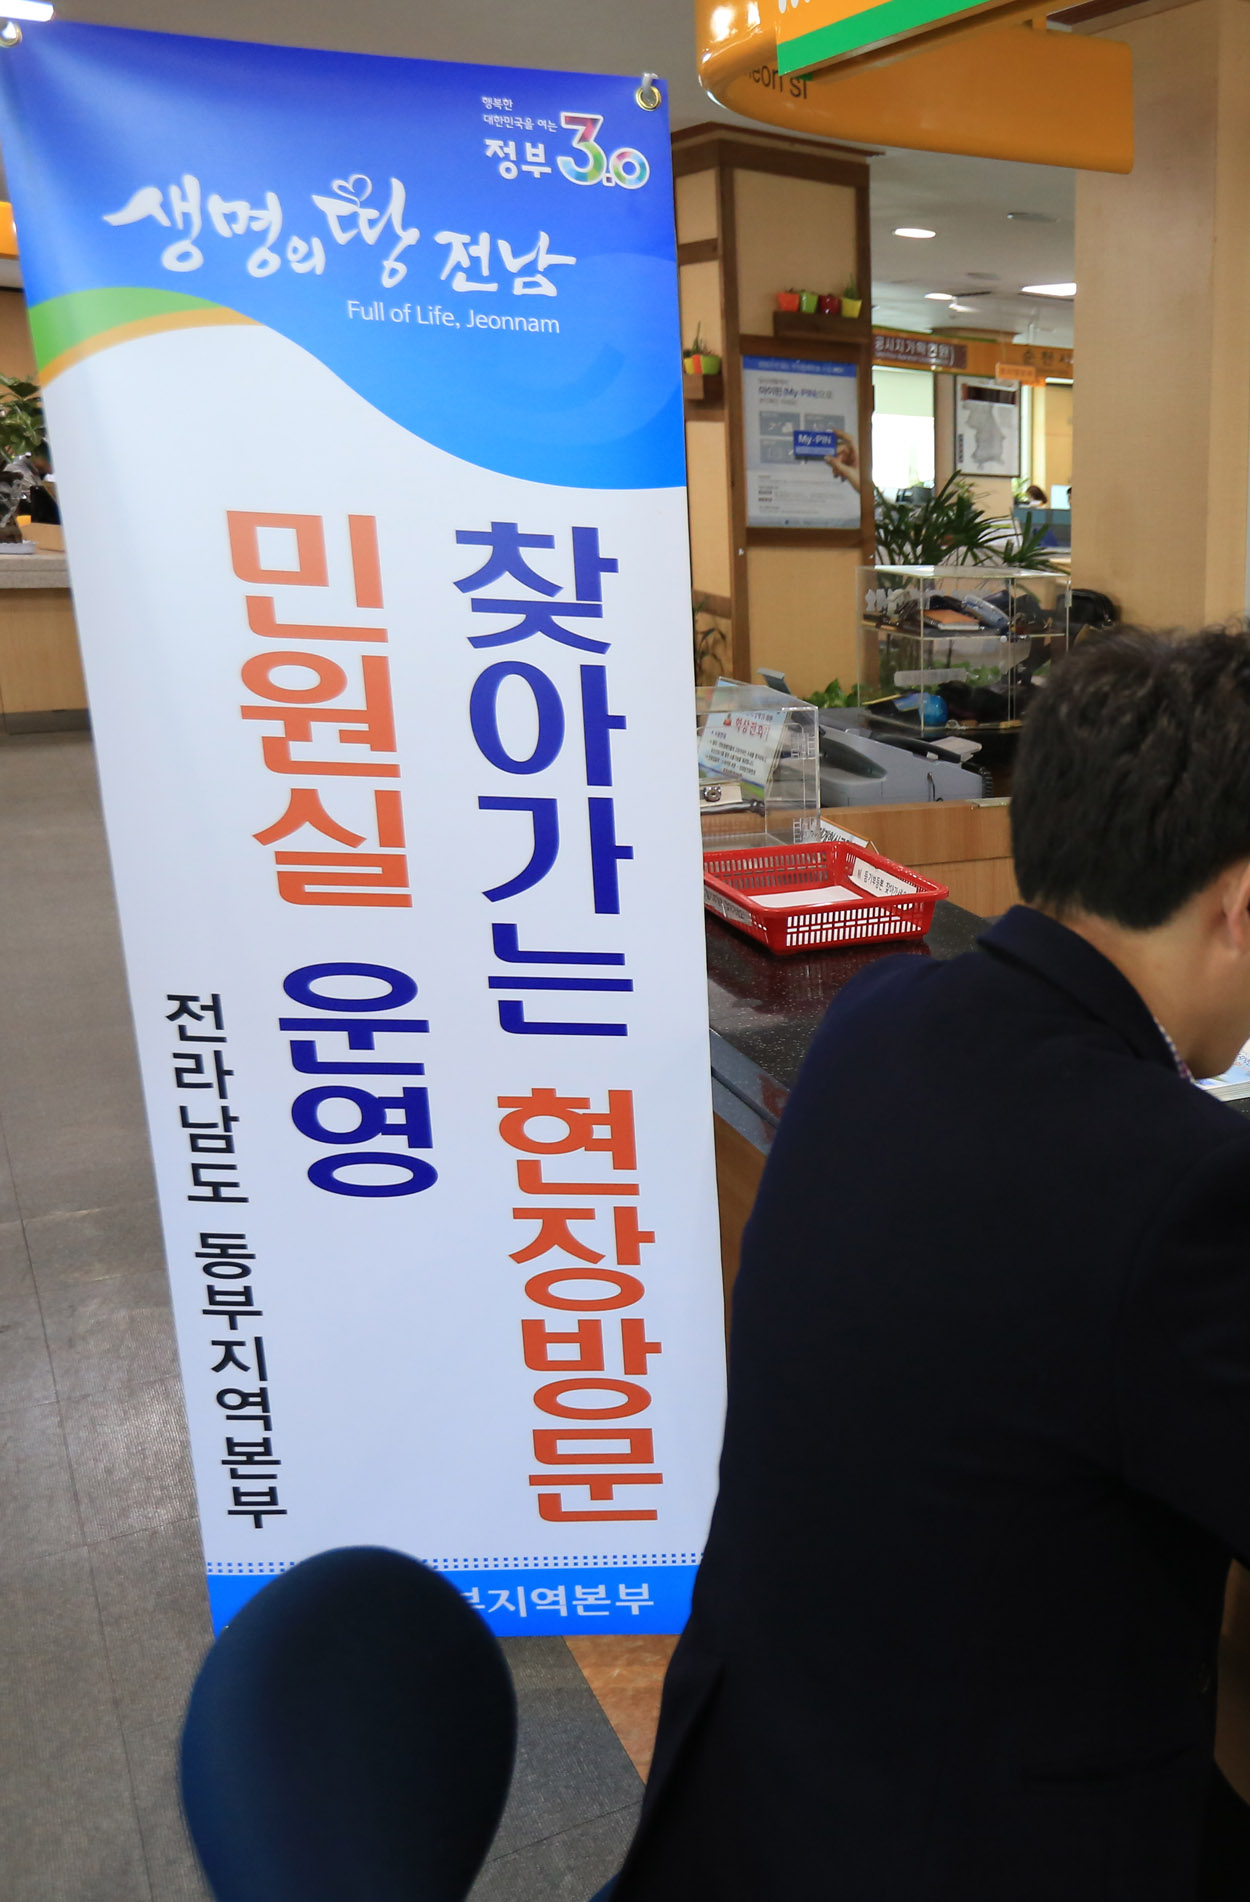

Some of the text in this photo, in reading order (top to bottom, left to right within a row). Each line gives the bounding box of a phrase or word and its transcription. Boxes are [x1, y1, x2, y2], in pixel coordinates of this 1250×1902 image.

[481, 96, 513, 111] 행복한
[483, 114, 558, 132] 대한민국을 여는
[484, 111, 651, 190] 정부 3.0
[434, 229, 577, 297] 전남
[347, 300, 561, 334] Full of Life, Jeonnam
[226, 510, 439, 1198] 민원실 운영
[452, 521, 664, 1523] 찾아가는 현장방문
[165, 993, 288, 1529] 전라남도 동부지역본부
